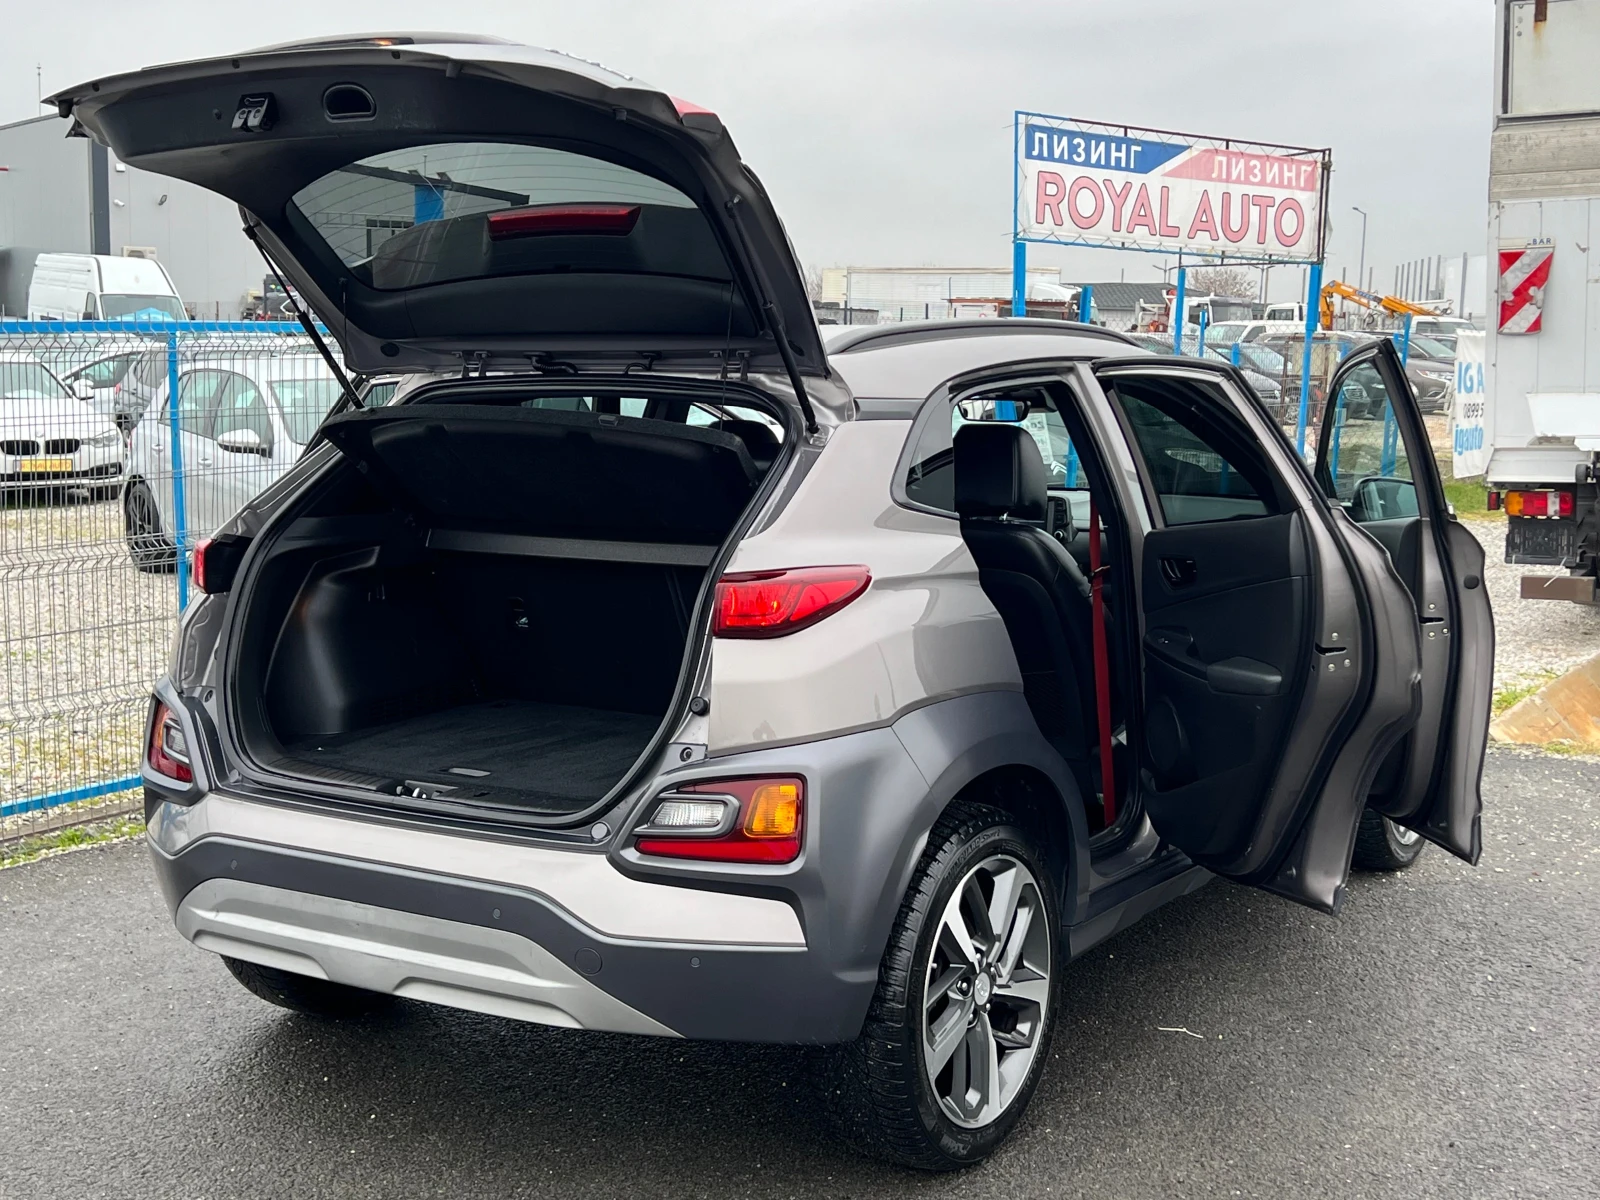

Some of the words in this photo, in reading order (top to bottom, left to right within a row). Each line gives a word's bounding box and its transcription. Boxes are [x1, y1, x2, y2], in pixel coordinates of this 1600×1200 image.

[1032, 132, 1142, 169] ЛИЗИНГ
[1211, 156, 1312, 188] ЛИЗИНГ
[1035, 170, 1180, 238] ROYAL
[1187, 189, 1304, 247] AUTO
